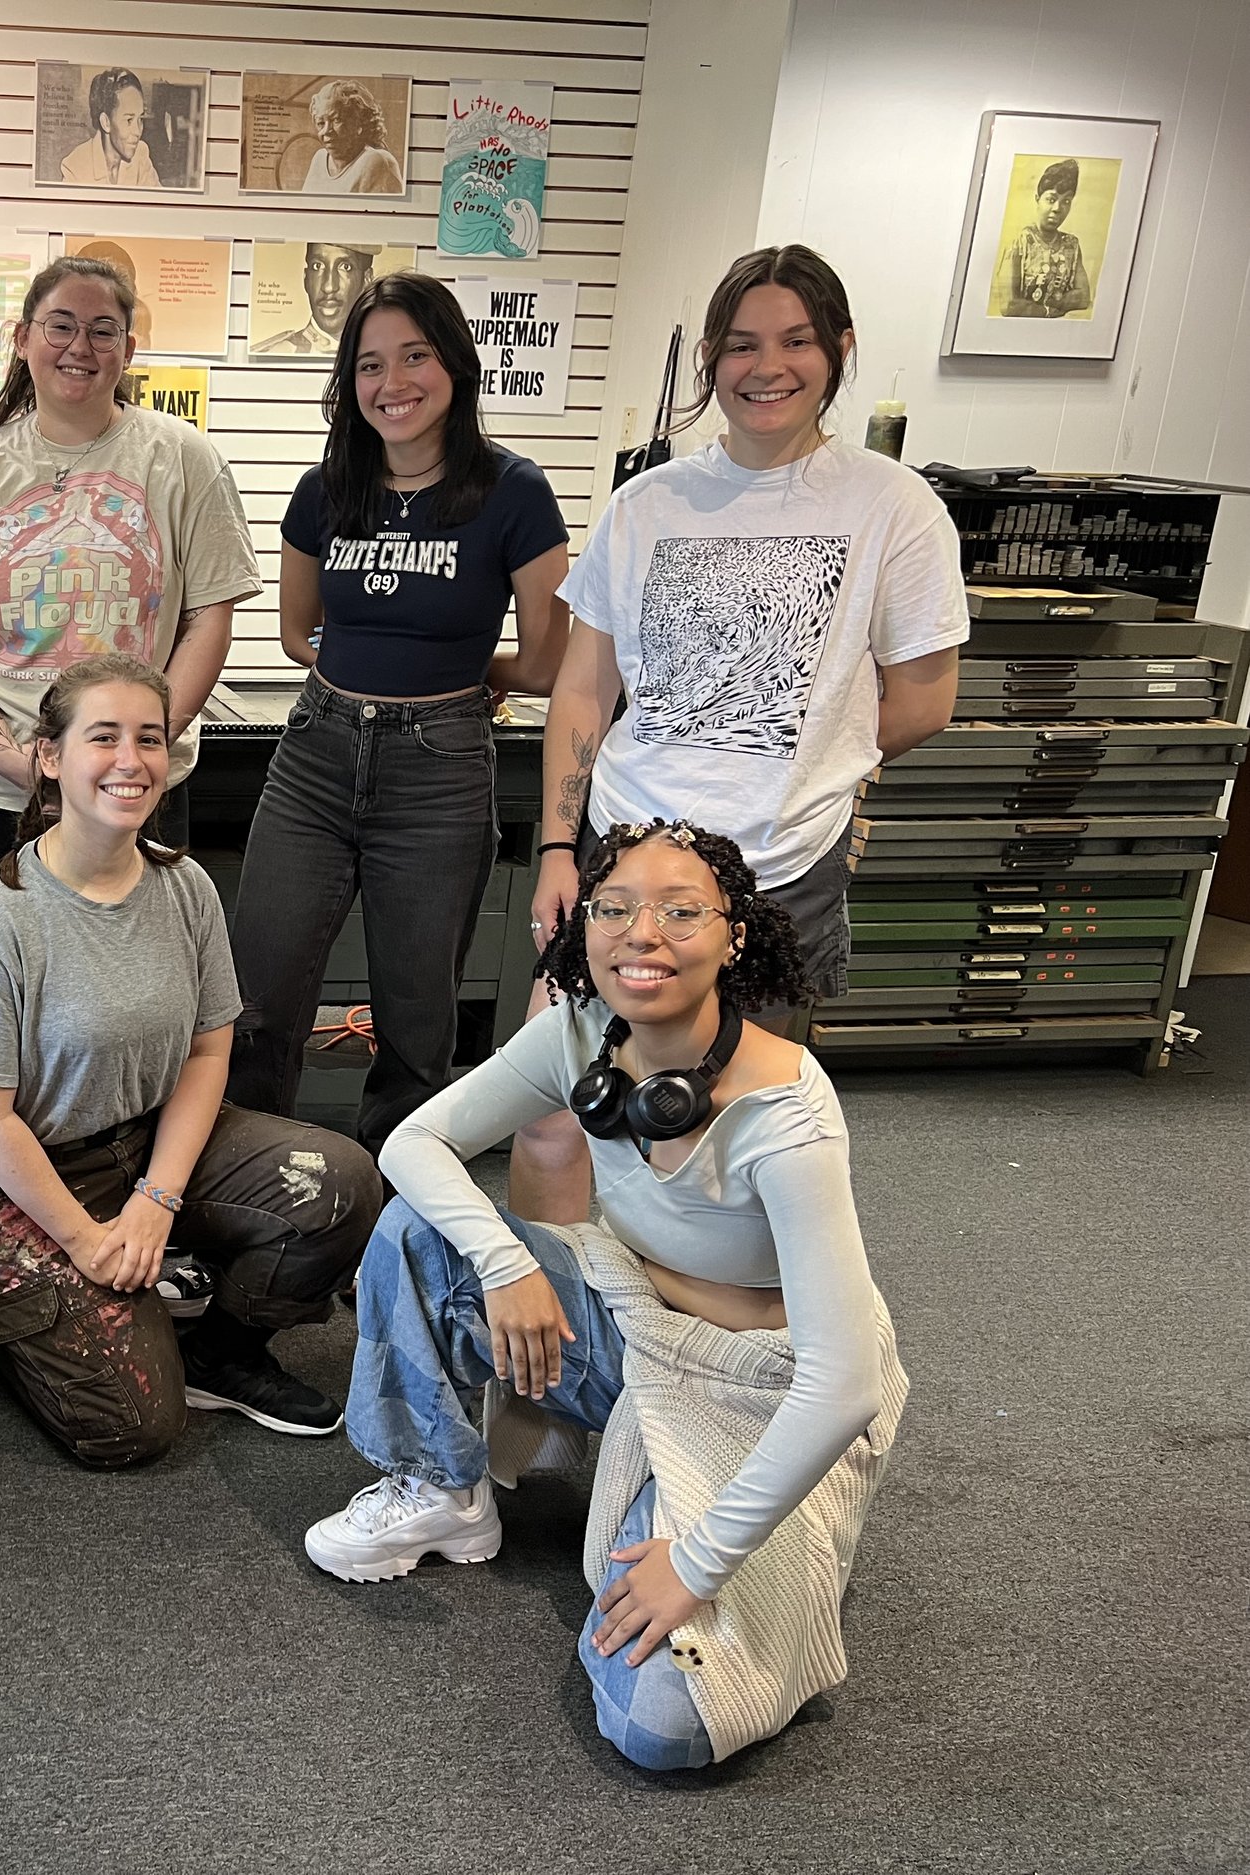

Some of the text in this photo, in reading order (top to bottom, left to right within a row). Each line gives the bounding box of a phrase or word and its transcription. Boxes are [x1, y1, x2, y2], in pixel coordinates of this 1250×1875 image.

[453, 95, 549, 131] Little Rhody
[480, 137, 500, 149] HAS
[490, 144, 511, 157] NO
[468, 156, 518, 180] SPACE
[463, 190, 479, 200] for
[490, 292, 538, 319] WHITE
[500, 348, 514, 368] IS
[501, 370, 544, 396] VIRUS
[152, 391, 200, 417] WANT
[376, 531, 411, 541] UNIVERSITY
[324, 535, 459, 580] STATE CHAMPS
[10, 562, 131, 602] Pink
[0, 597, 141, 635] Floyd
[1, 668, 35, 681] DARK
[761, 660, 811, 705] WAVE
[653, 1089, 679, 1119] JBL
